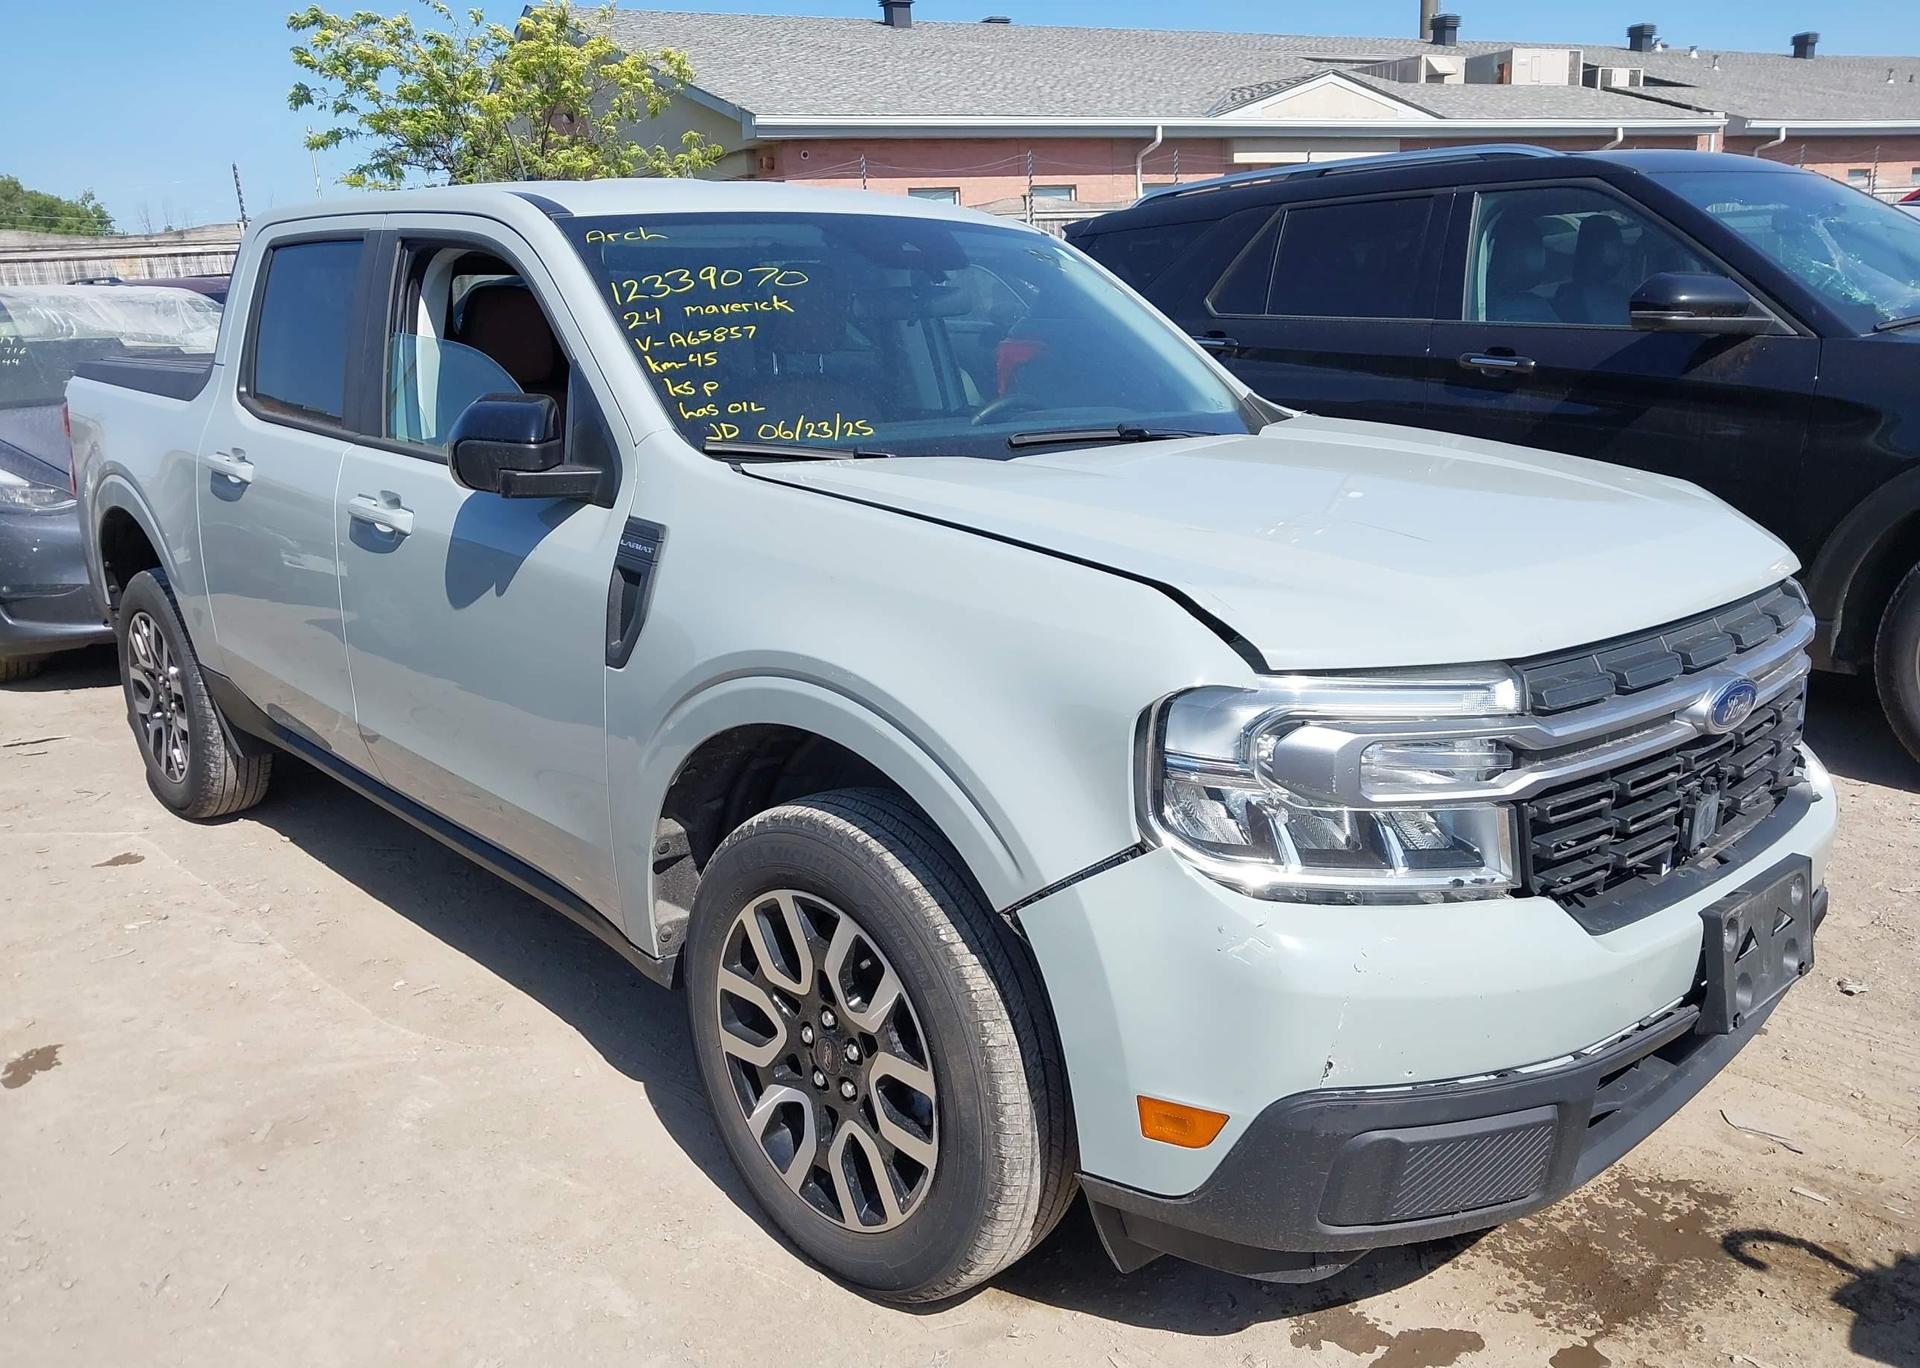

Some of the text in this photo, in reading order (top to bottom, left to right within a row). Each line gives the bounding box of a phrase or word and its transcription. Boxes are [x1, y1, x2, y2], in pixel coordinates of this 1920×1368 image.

[586, 227, 669, 244] Arch
[610, 266, 809, 305] 12339070
[624, 308, 661, 329] 24
[680, 402, 719, 420] has
[706, 413, 874, 441] JD 06/23/25
[620, 539, 655, 553] LARIAT
[1722, 691, 1752, 722] Ford
